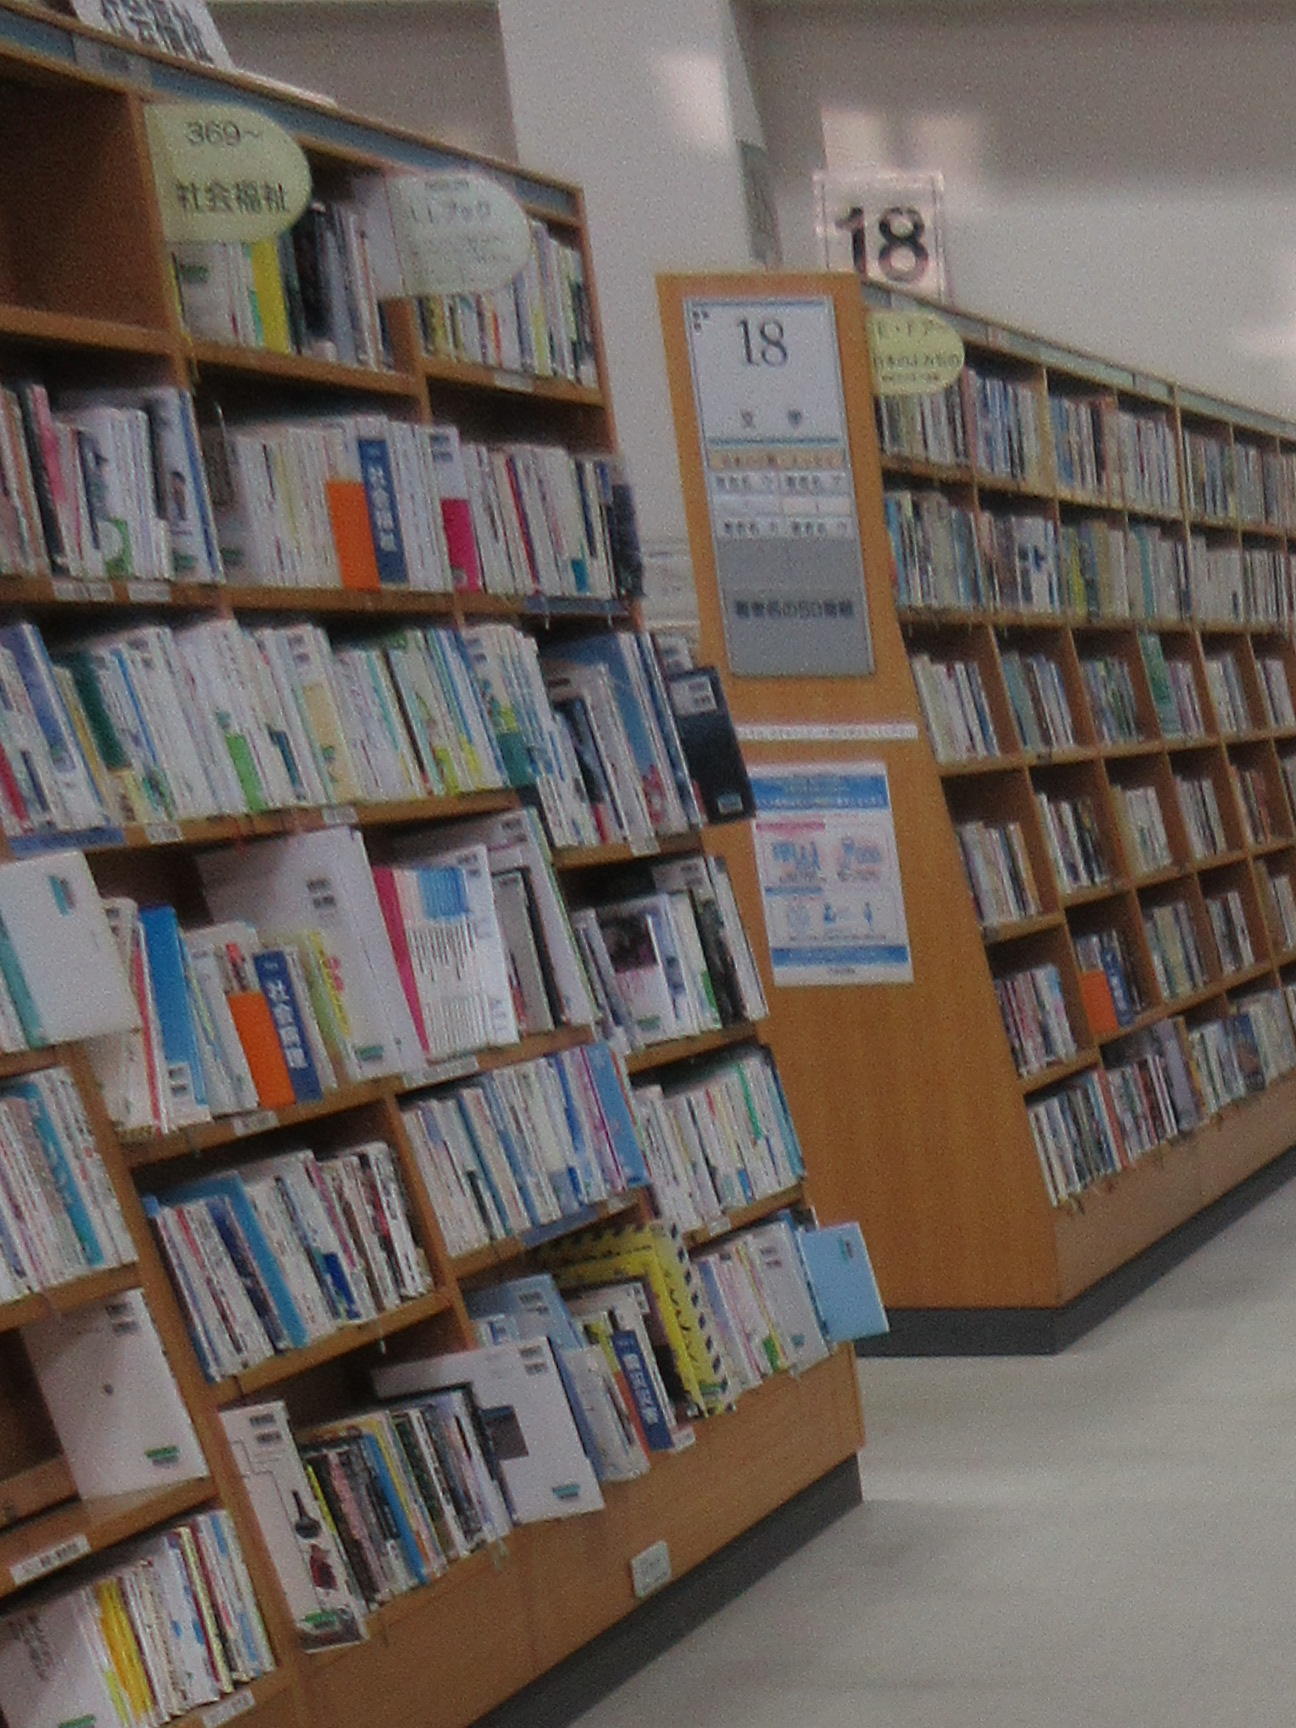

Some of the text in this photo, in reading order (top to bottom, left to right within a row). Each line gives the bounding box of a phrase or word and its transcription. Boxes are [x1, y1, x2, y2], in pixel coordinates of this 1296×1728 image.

[174, 180, 288, 214] 社会福祉
[834, 205, 929, 283] 18
[736, 317, 789, 368] 18
